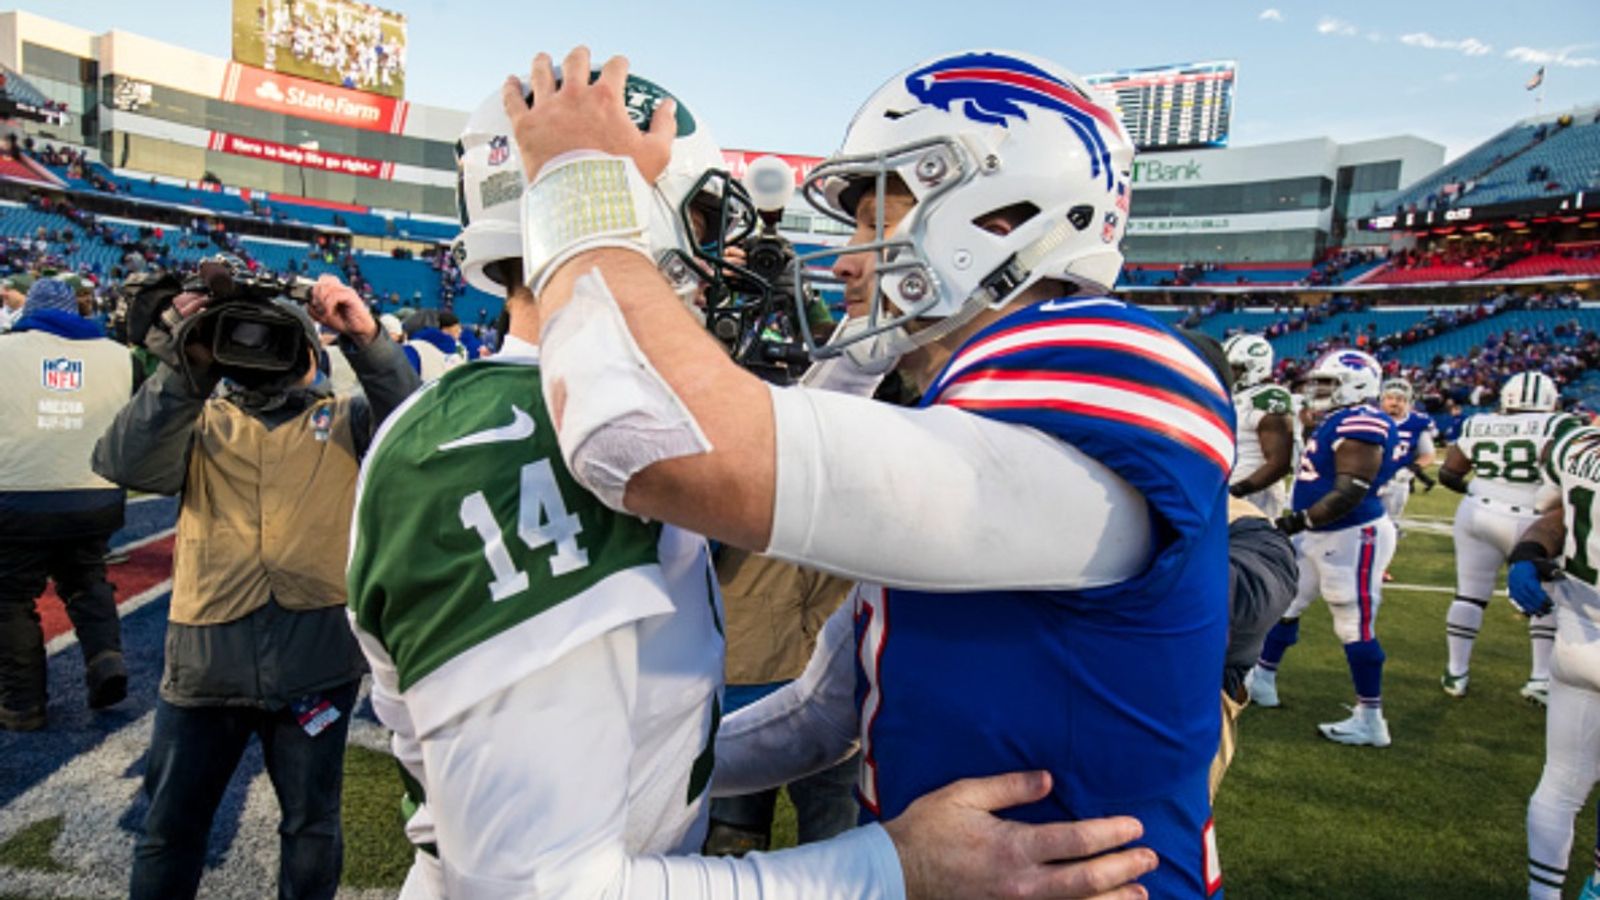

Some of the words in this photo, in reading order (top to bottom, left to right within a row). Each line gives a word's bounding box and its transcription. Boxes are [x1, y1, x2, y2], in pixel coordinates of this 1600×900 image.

[264, 145, 277, 157] to
[278, 147, 304, 164] help
[326, 156, 341, 169] go
[48, 371, 79, 389] NFL
[1471, 439, 1541, 483] 68
[459, 457, 589, 602] 14
